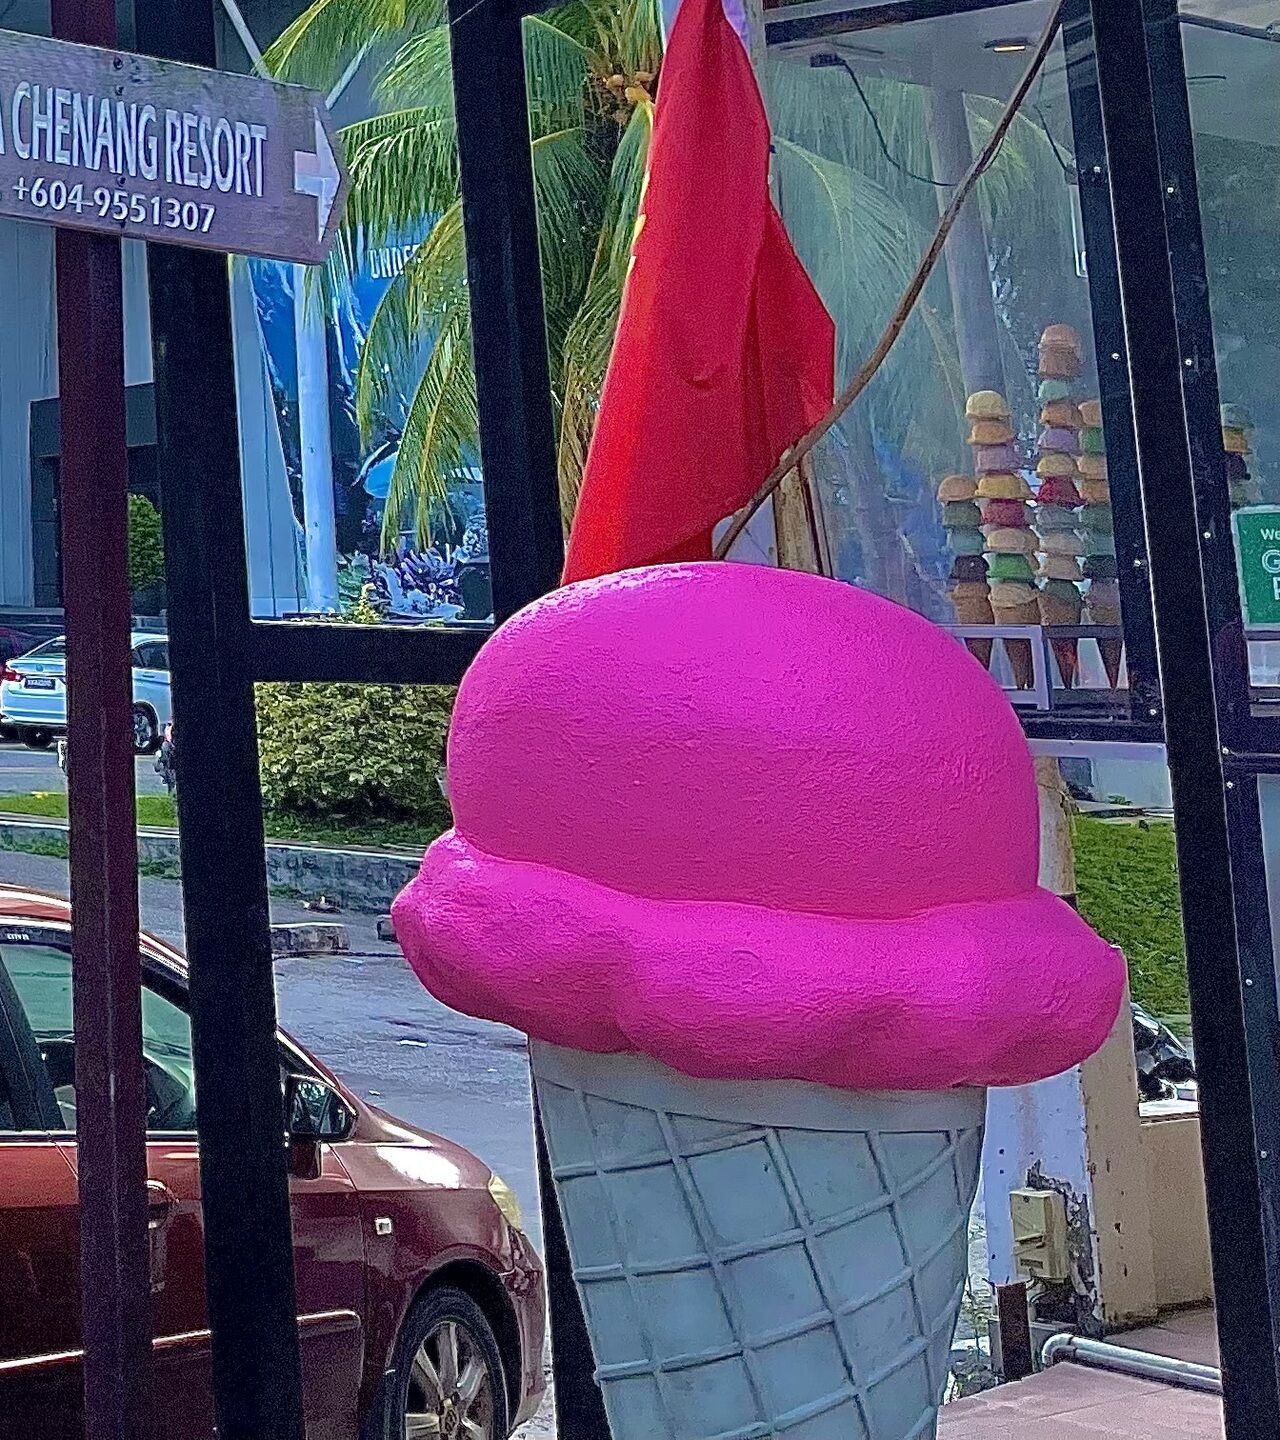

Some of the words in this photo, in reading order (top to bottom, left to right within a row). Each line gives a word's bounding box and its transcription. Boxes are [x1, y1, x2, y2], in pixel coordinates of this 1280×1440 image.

[11, 80, 159, 181] CHENANG
[165, 109, 267, 197] RESORT
[12, 176, 215, 233] +604-9551307
